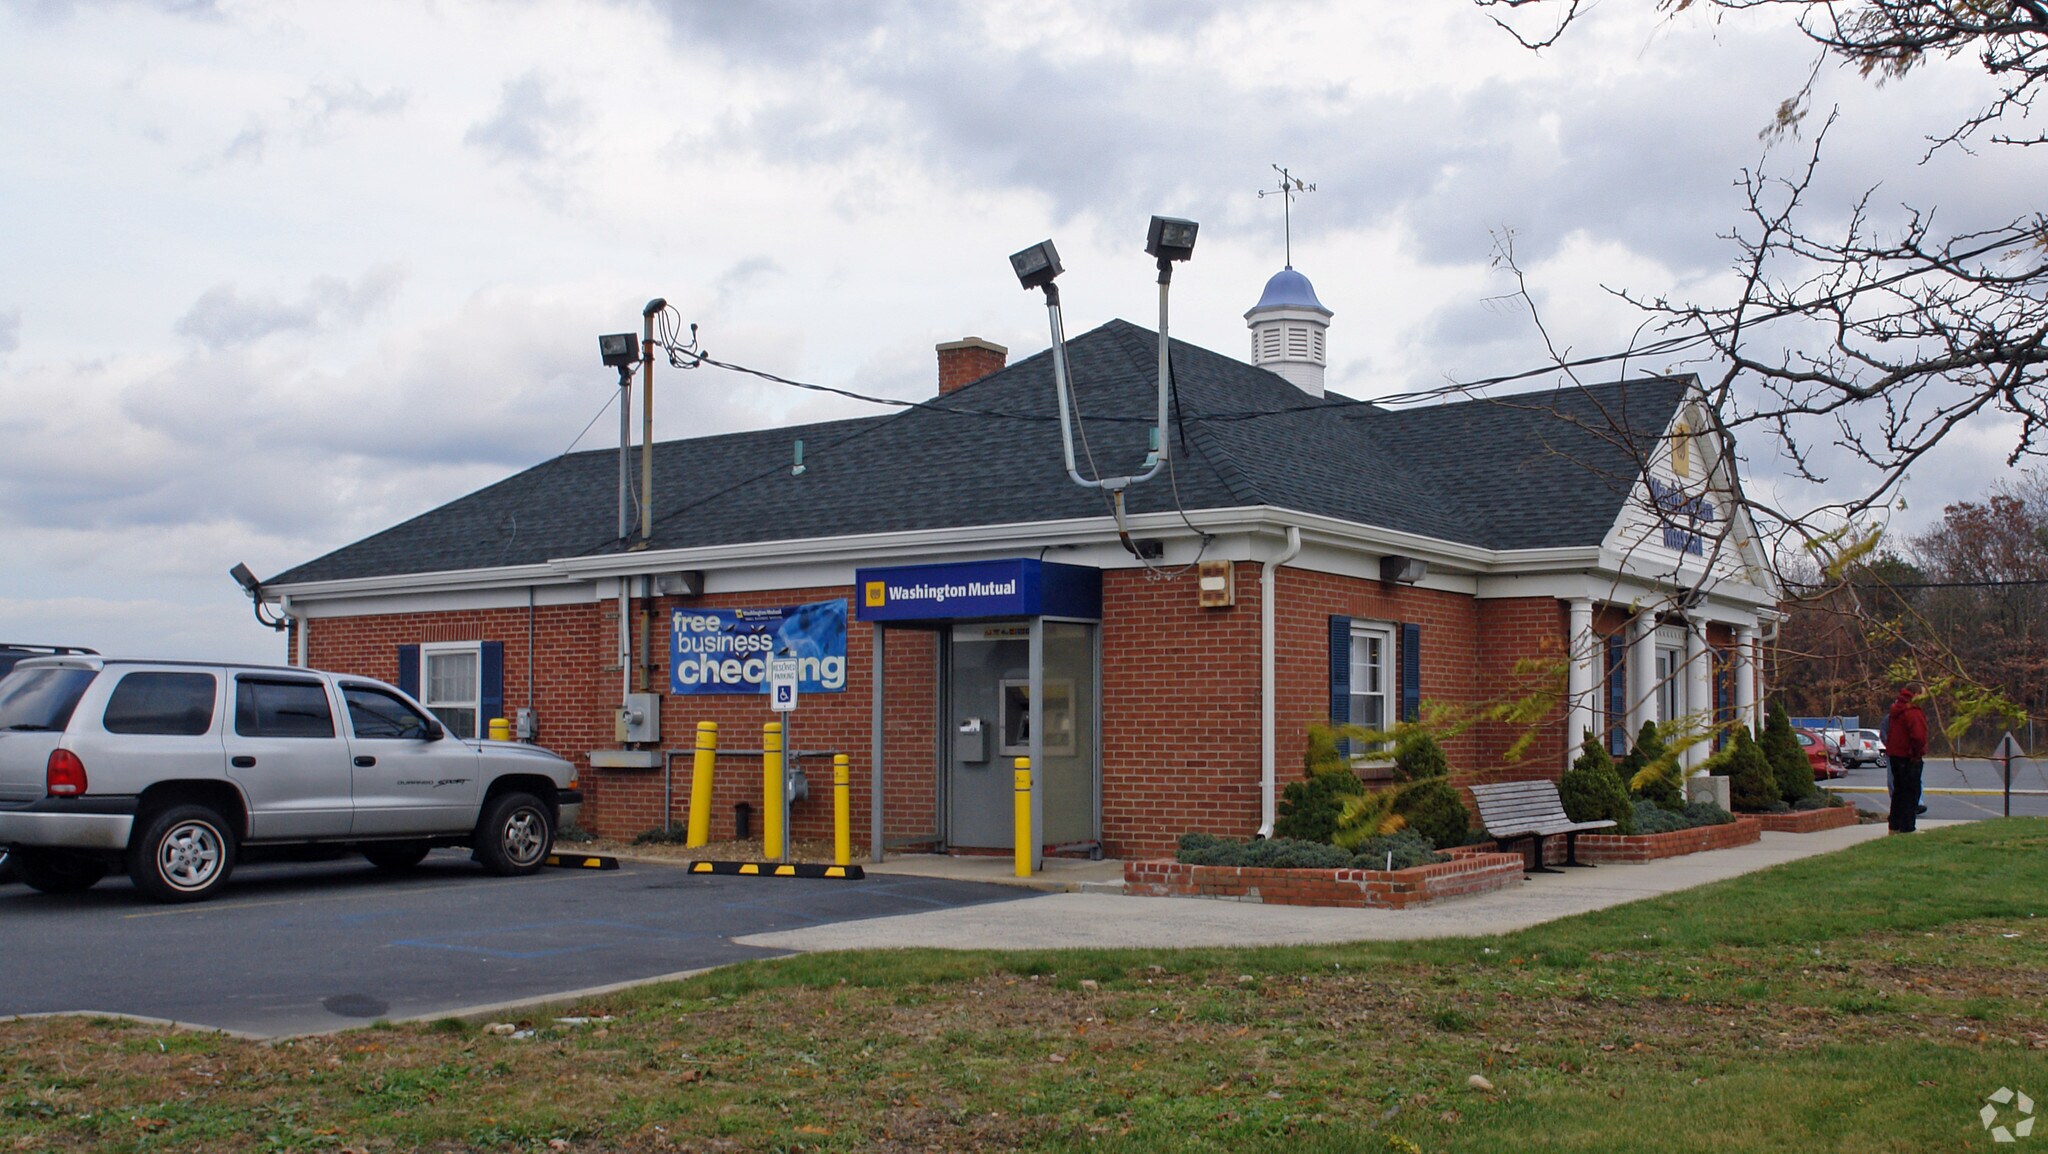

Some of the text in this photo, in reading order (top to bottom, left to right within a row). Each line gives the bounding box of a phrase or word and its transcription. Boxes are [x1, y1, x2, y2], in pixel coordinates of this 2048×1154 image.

[888, 579, 1016, 603] Washington Mutual
[673, 611, 721, 633] free
[678, 632, 773, 653] business
[678, 651, 845, 688] checng
